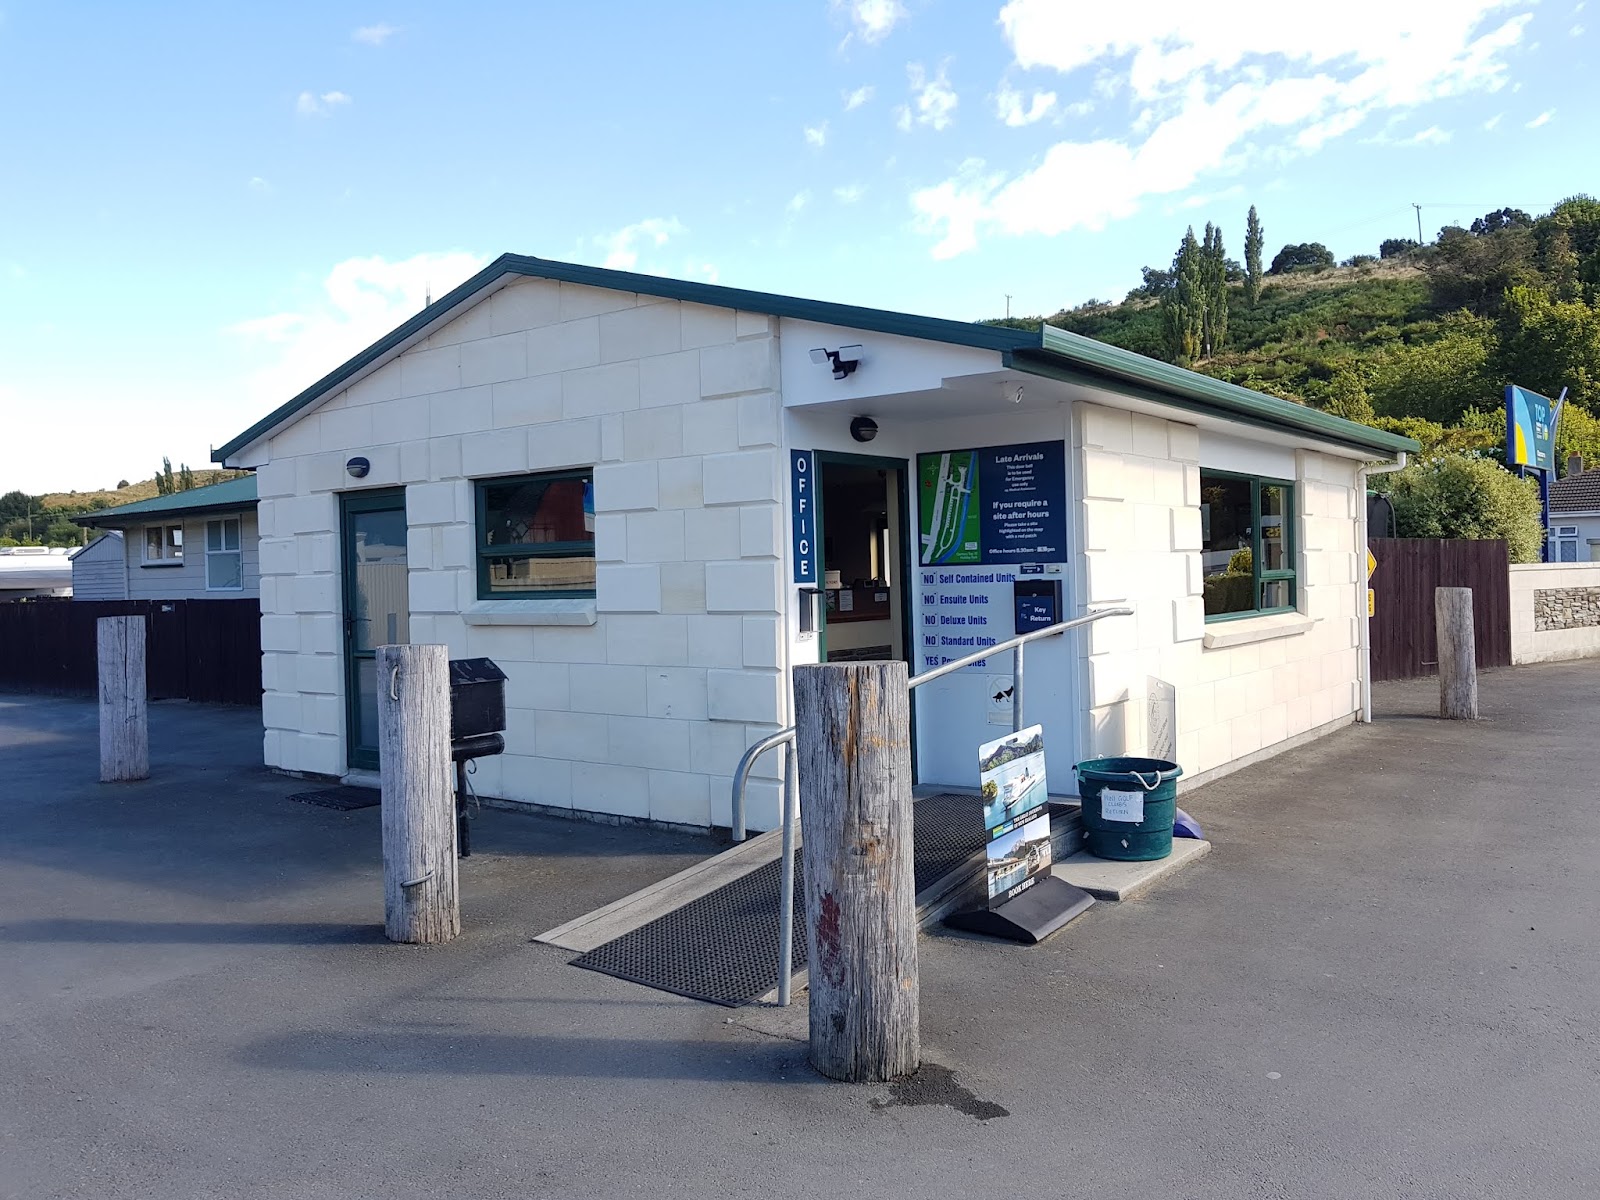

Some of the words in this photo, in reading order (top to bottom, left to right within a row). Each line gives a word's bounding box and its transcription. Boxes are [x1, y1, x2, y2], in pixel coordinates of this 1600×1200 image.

[1534, 404, 1546, 422] TOP
[995, 455, 1012, 463] Late
[1013, 452, 1044, 462] Arrivals
[1014, 499, 1042, 508] require
[797, 458, 809, 575] OFFICE
[924, 575, 934, 584] NO
[940, 574, 954, 584] Self
[956, 573, 993, 583] Contained
[996, 573, 1015, 582] Units
[924, 596, 934, 604] NO
[940, 595, 966, 604] Ensuite
[970, 595, 988, 604] Units
[925, 616, 935, 625] NO
[940, 616, 965, 625] Deluxe
[968, 616, 987, 625] Units
[926, 636, 936, 645] NO
[941, 636, 974, 646] Standard
[976, 637, 995, 646] Units
[925, 656, 938, 665] YES
[1008, 884, 1022, 898] BOOK
[1022, 877, 1035, 890] HERE
